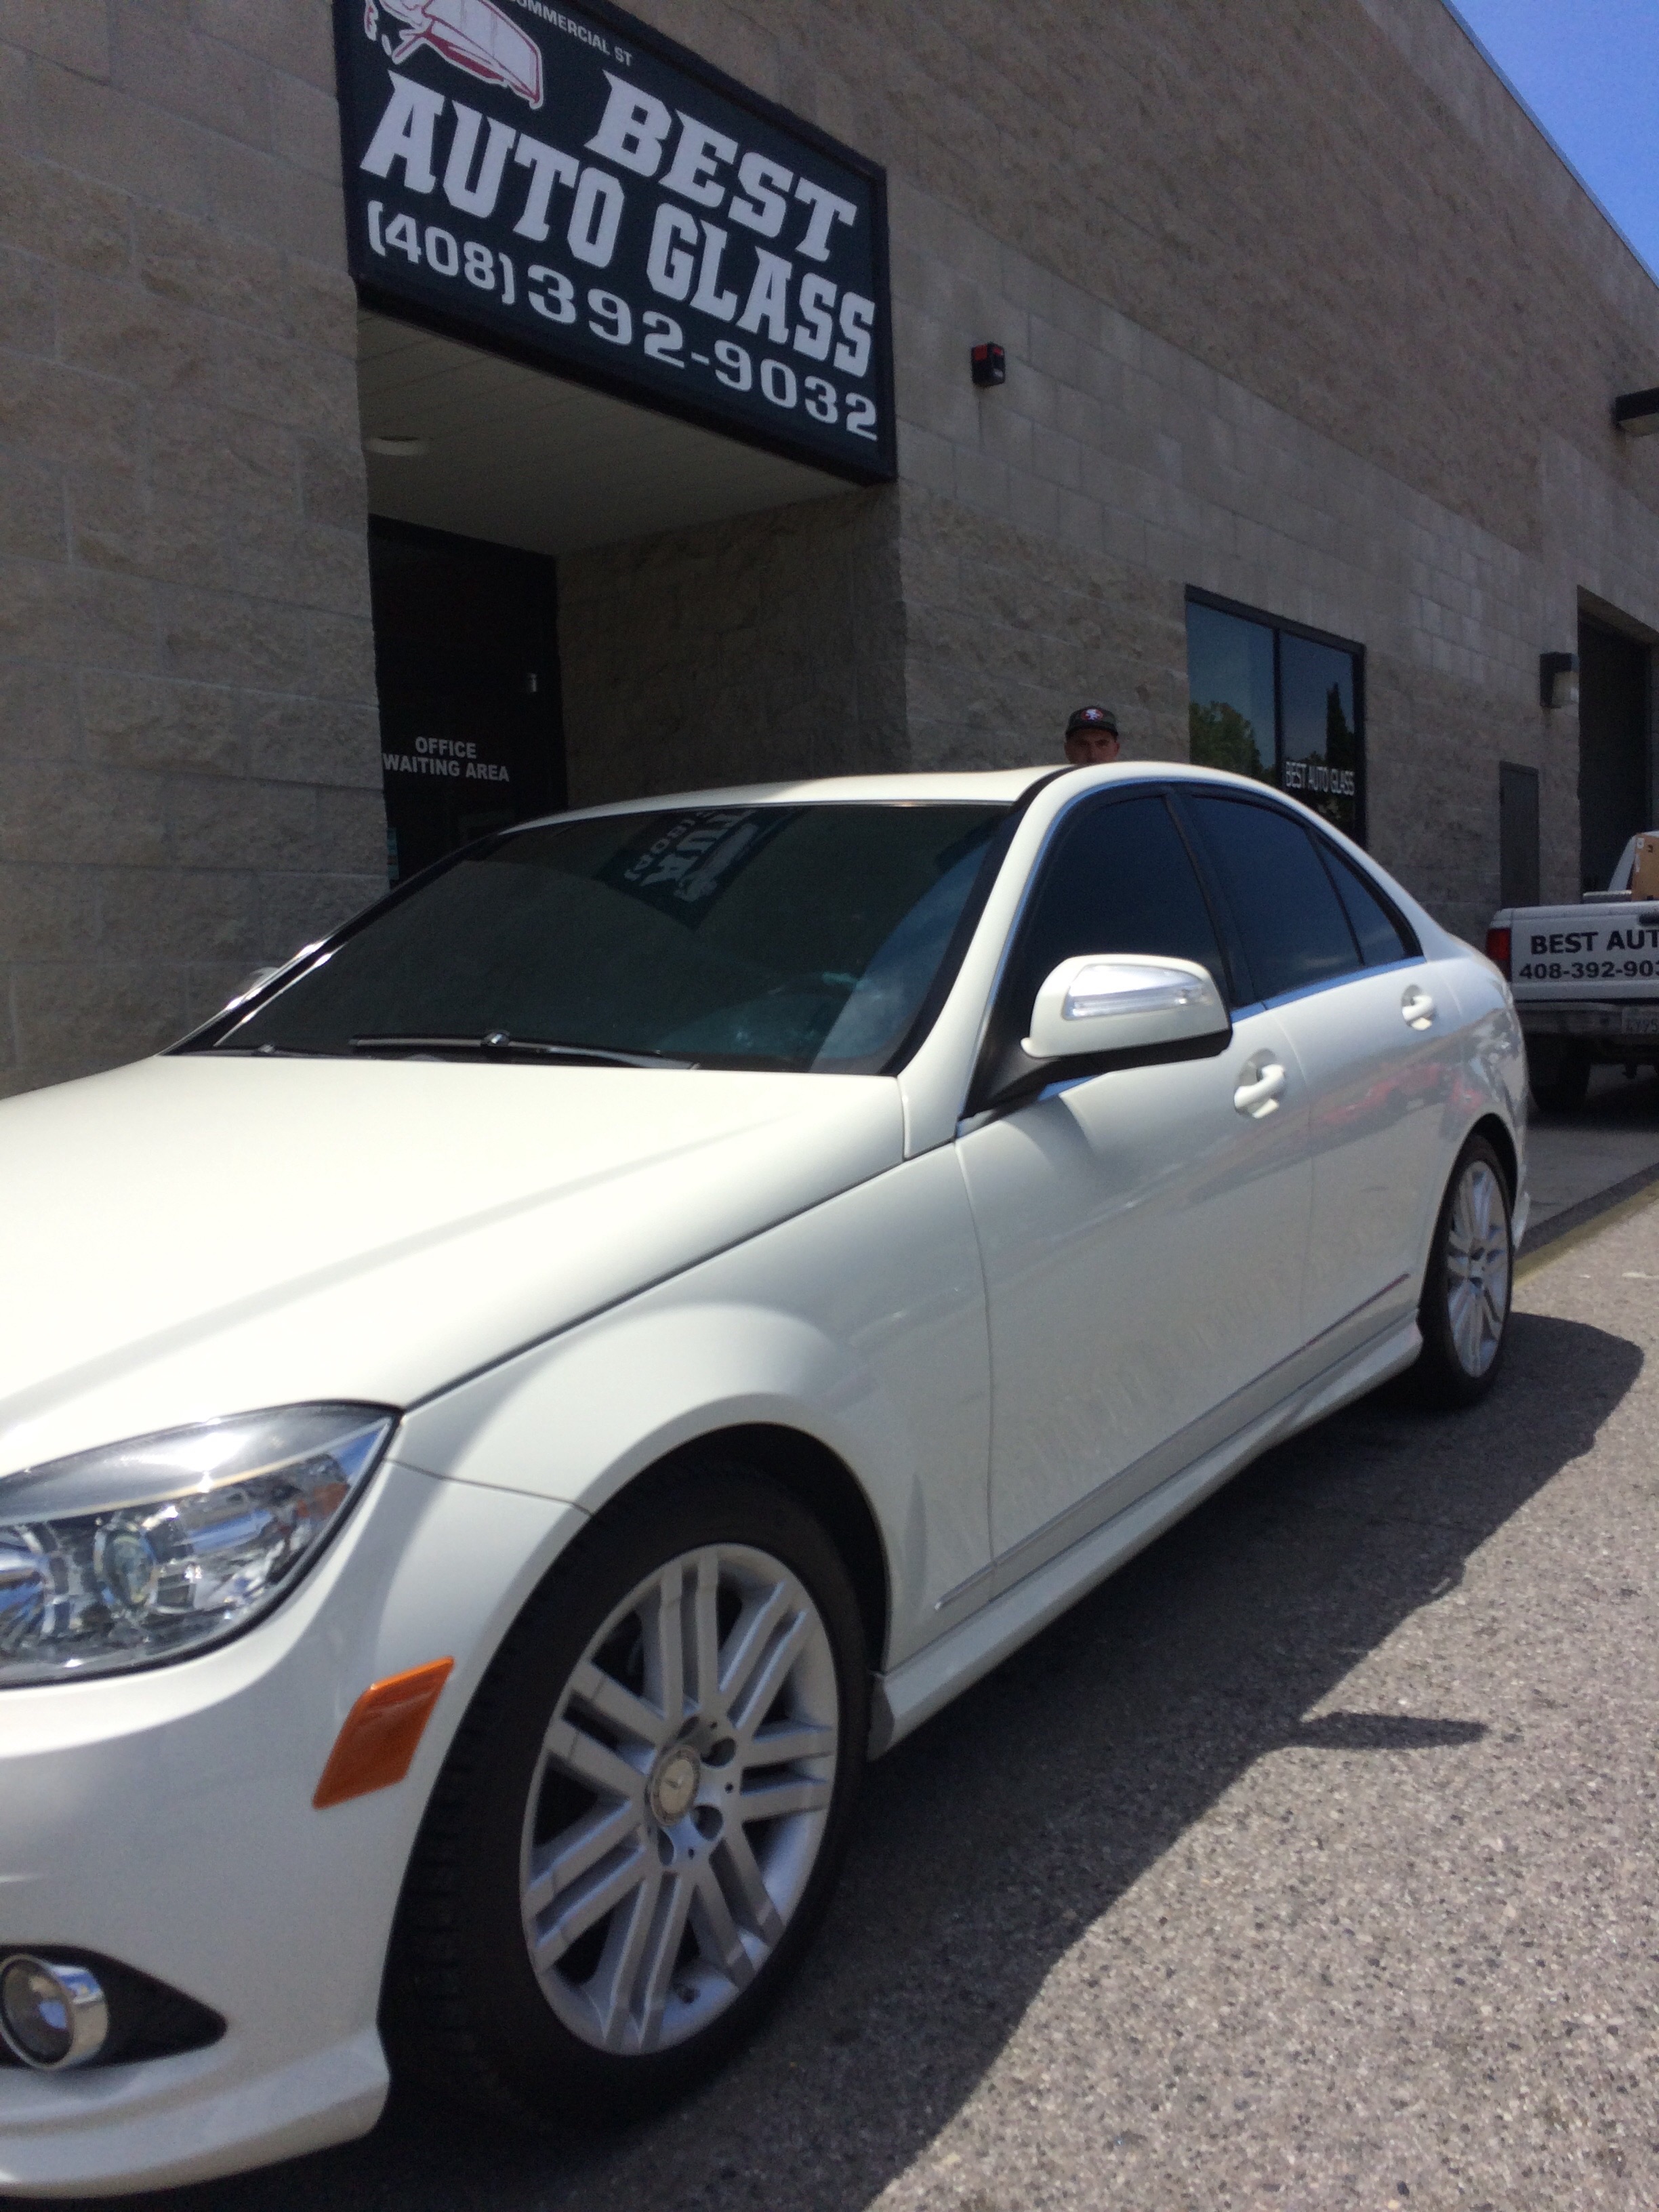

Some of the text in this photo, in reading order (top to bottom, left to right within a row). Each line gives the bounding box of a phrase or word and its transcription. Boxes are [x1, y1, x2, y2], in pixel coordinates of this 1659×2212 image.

[510, 0, 632, 66] OMMERCIAL ST
[584, 69, 858, 263] BEST
[360, 69, 876, 378] AUTO GLASS
[415, 736, 477, 759] OFFICE
[382, 753, 510, 781] WAITING AREA
[1286, 761, 1355, 796] BEST AUTO GLASS
[1530, 931, 1599, 955] BEST
